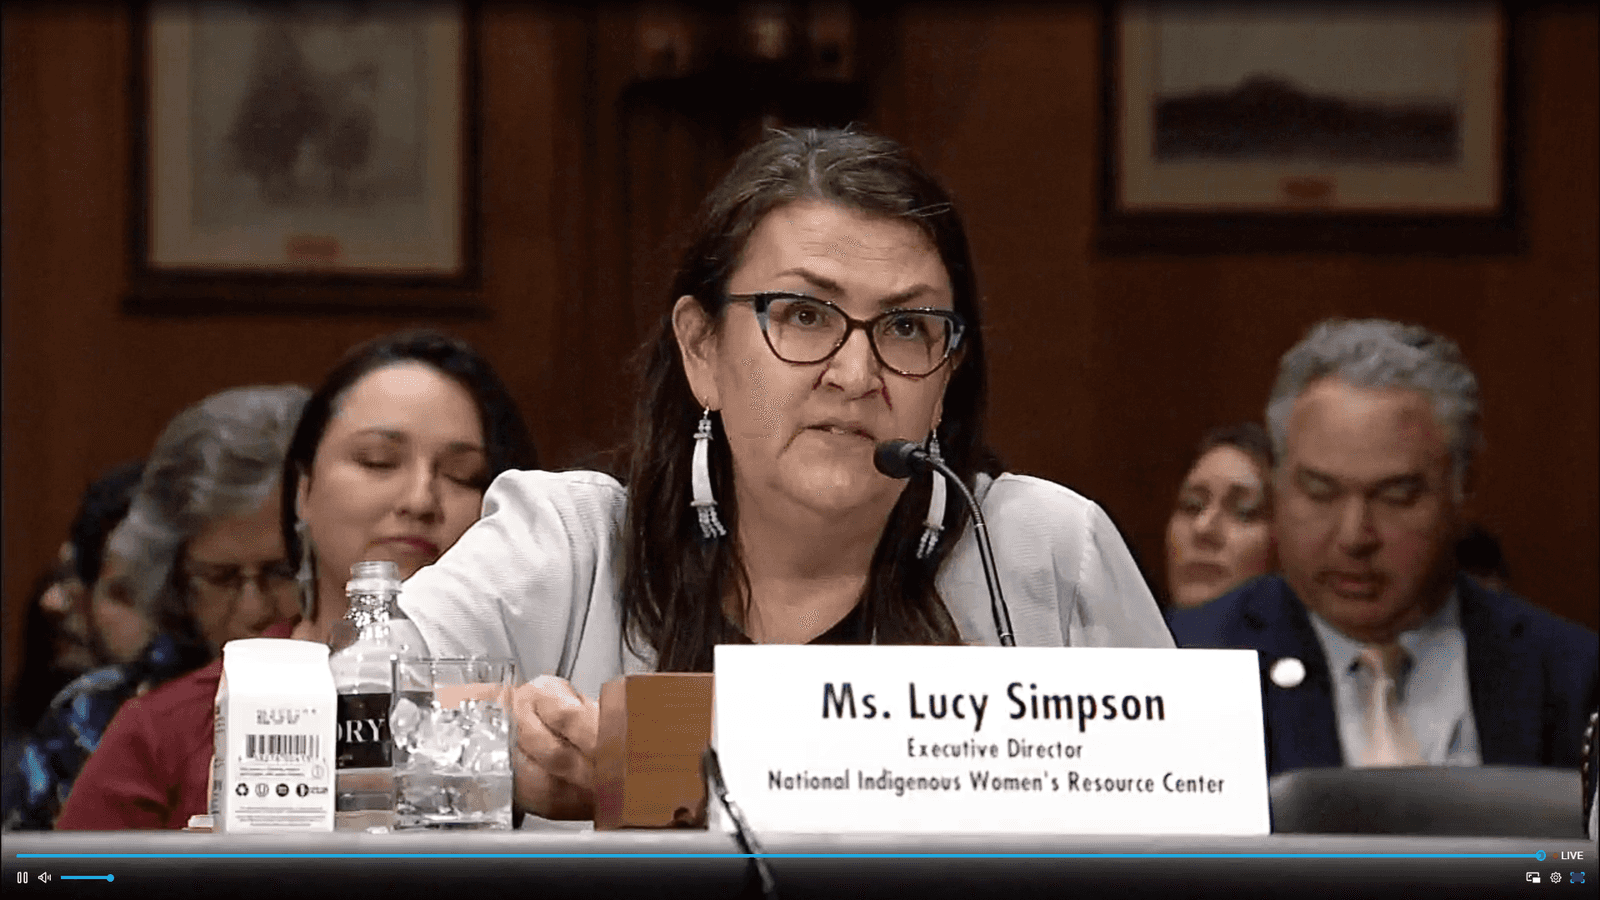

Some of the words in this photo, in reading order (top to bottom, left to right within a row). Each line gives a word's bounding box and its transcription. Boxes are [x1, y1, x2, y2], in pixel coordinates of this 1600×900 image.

[821, 682, 891, 720] Ms.
[909, 682, 989, 733] Lucy
[1006, 681, 1166, 734] Simpson
[907, 737, 999, 759] Executive
[1007, 738, 1084, 760] Director
[767, 768, 850, 791] National
[857, 768, 962, 797] Indigenous
[969, 770, 1060, 792] Women's
[1067, 771, 1156, 793] Resource
[1162, 772, 1226, 794] Center
